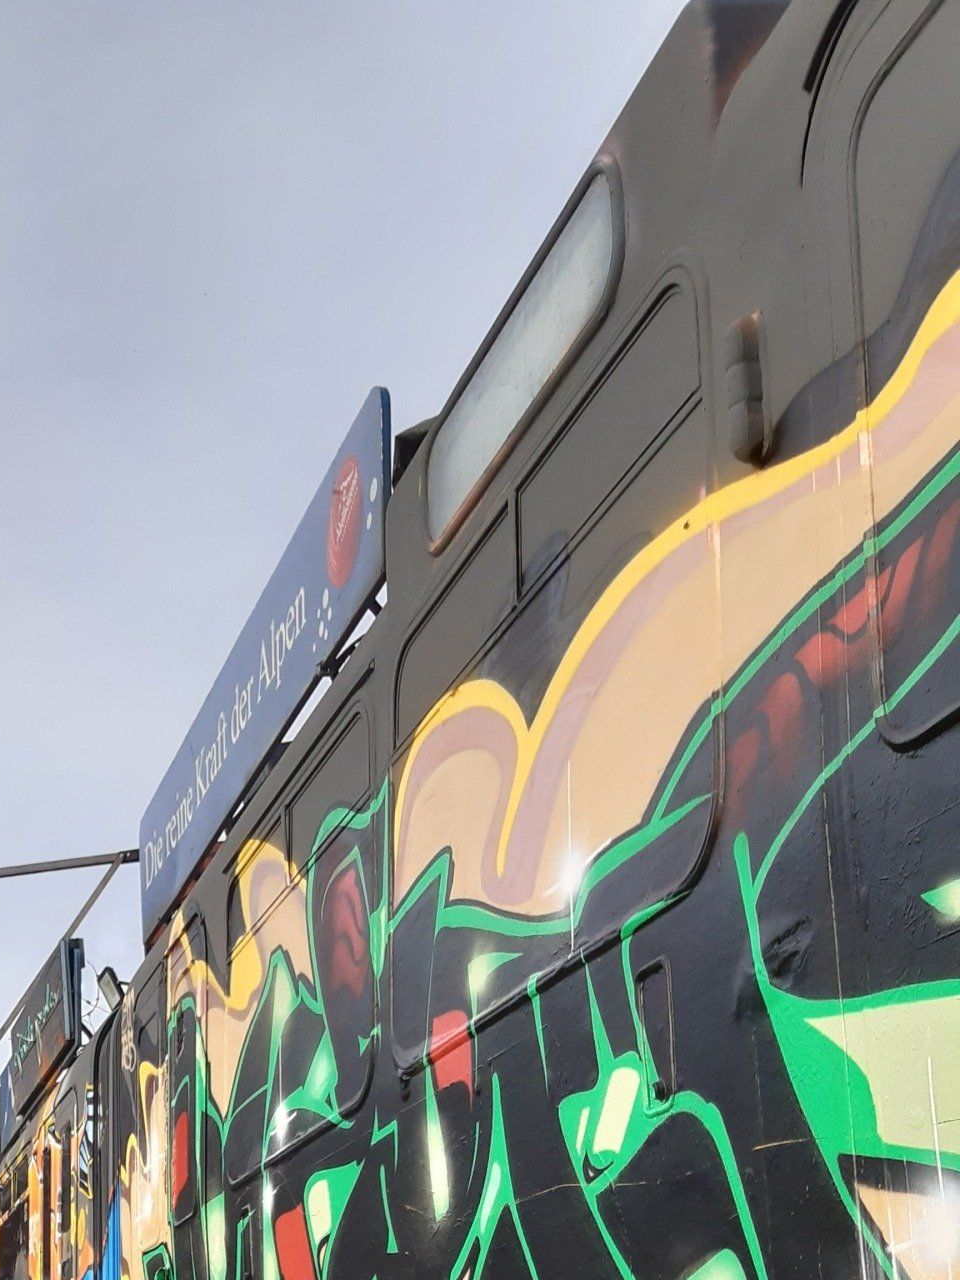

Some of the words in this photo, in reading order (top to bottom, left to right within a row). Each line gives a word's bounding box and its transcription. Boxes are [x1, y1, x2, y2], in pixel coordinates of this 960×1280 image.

[143, 830, 163, 891] Die
[165, 787, 193, 858] reine
[194, 711, 228, 808] Kraft
[231, 675, 254, 744] der
[256, 586, 307, 704] Alpen
